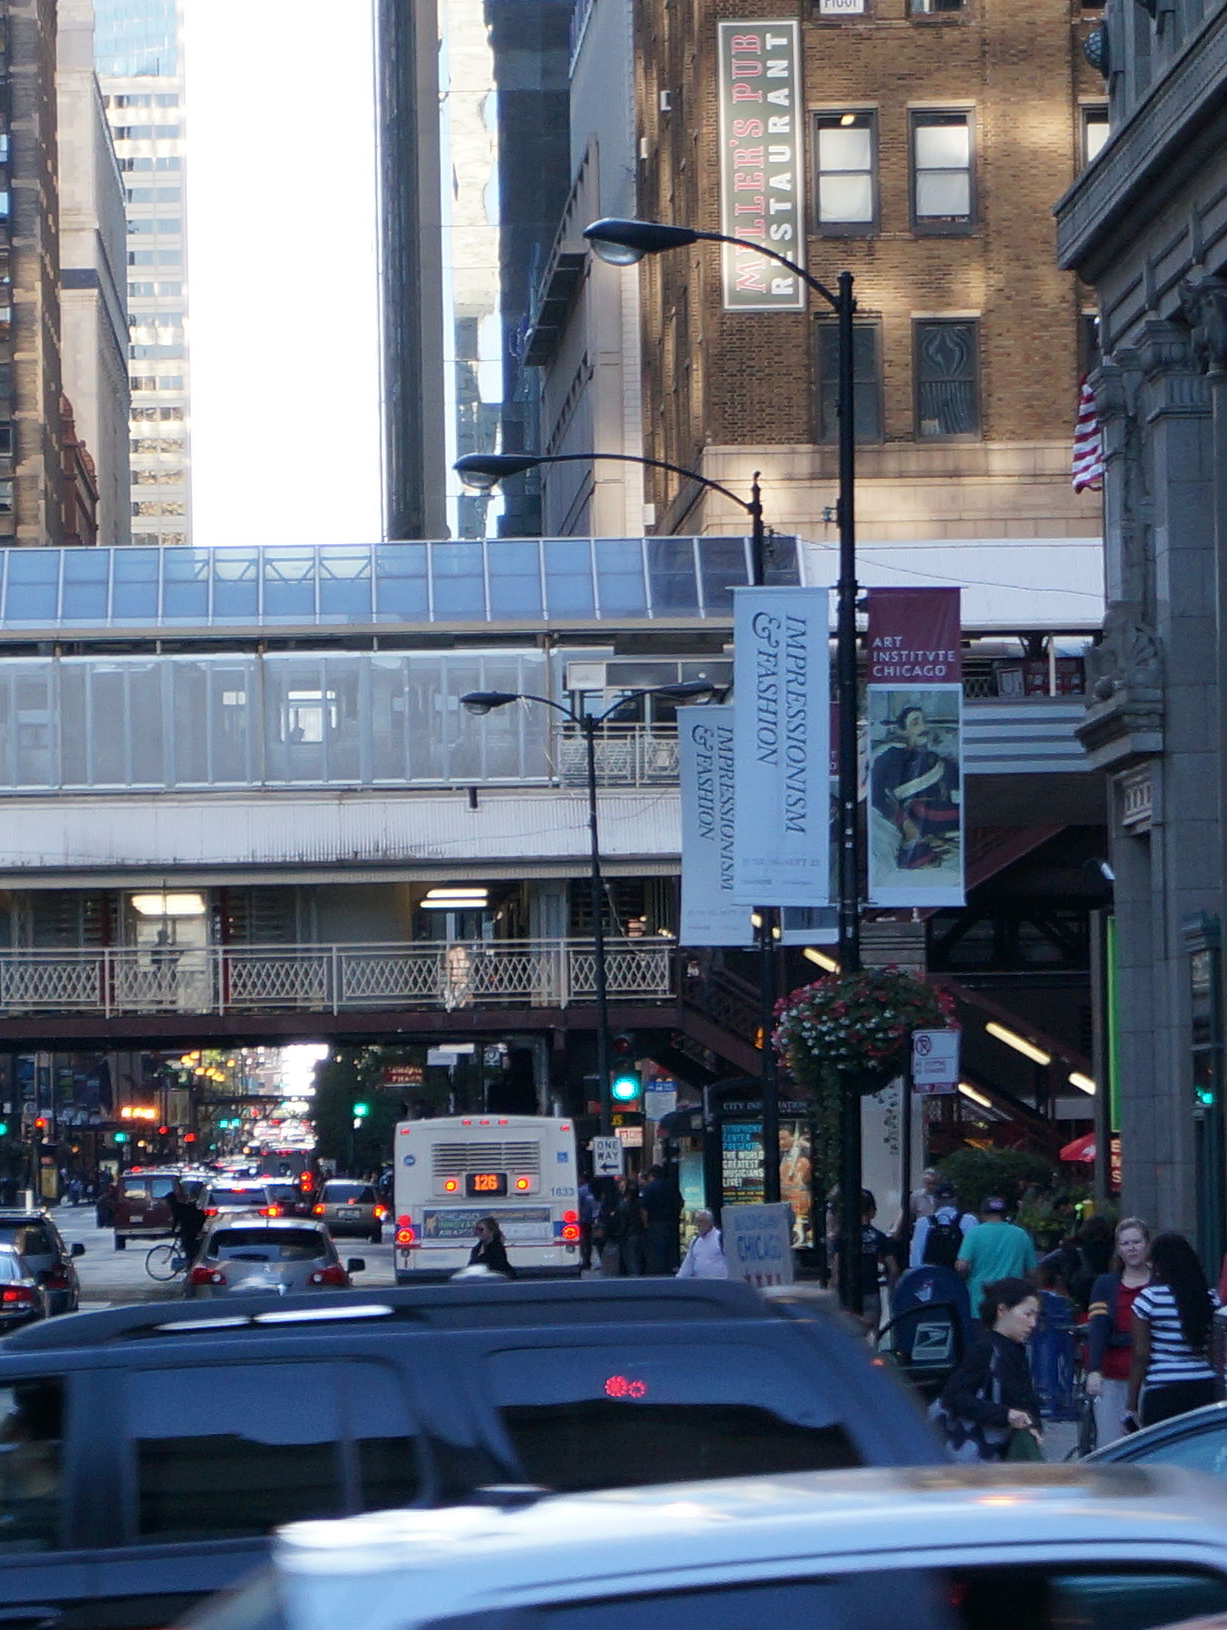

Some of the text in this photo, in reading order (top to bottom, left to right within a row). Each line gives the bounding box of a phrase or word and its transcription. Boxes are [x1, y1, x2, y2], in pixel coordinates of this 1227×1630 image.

[730, 34, 763, 104] PUB
[766, 33, 794, 295] RESTAURANT
[872, 636, 902, 648] ART
[872, 665, 946, 677] CHICAGO
[752, 611, 781, 766] & FASHION
[785, 615, 807, 834] IMPRESSIONISM
[696, 752, 715, 840] FASHION
[716, 726, 735, 890] IMPRESSIONISM
[597, 1141, 619, 1150] ONE
[597, 1151, 619, 1160] WAY
[474, 1174, 498, 1191] 126
